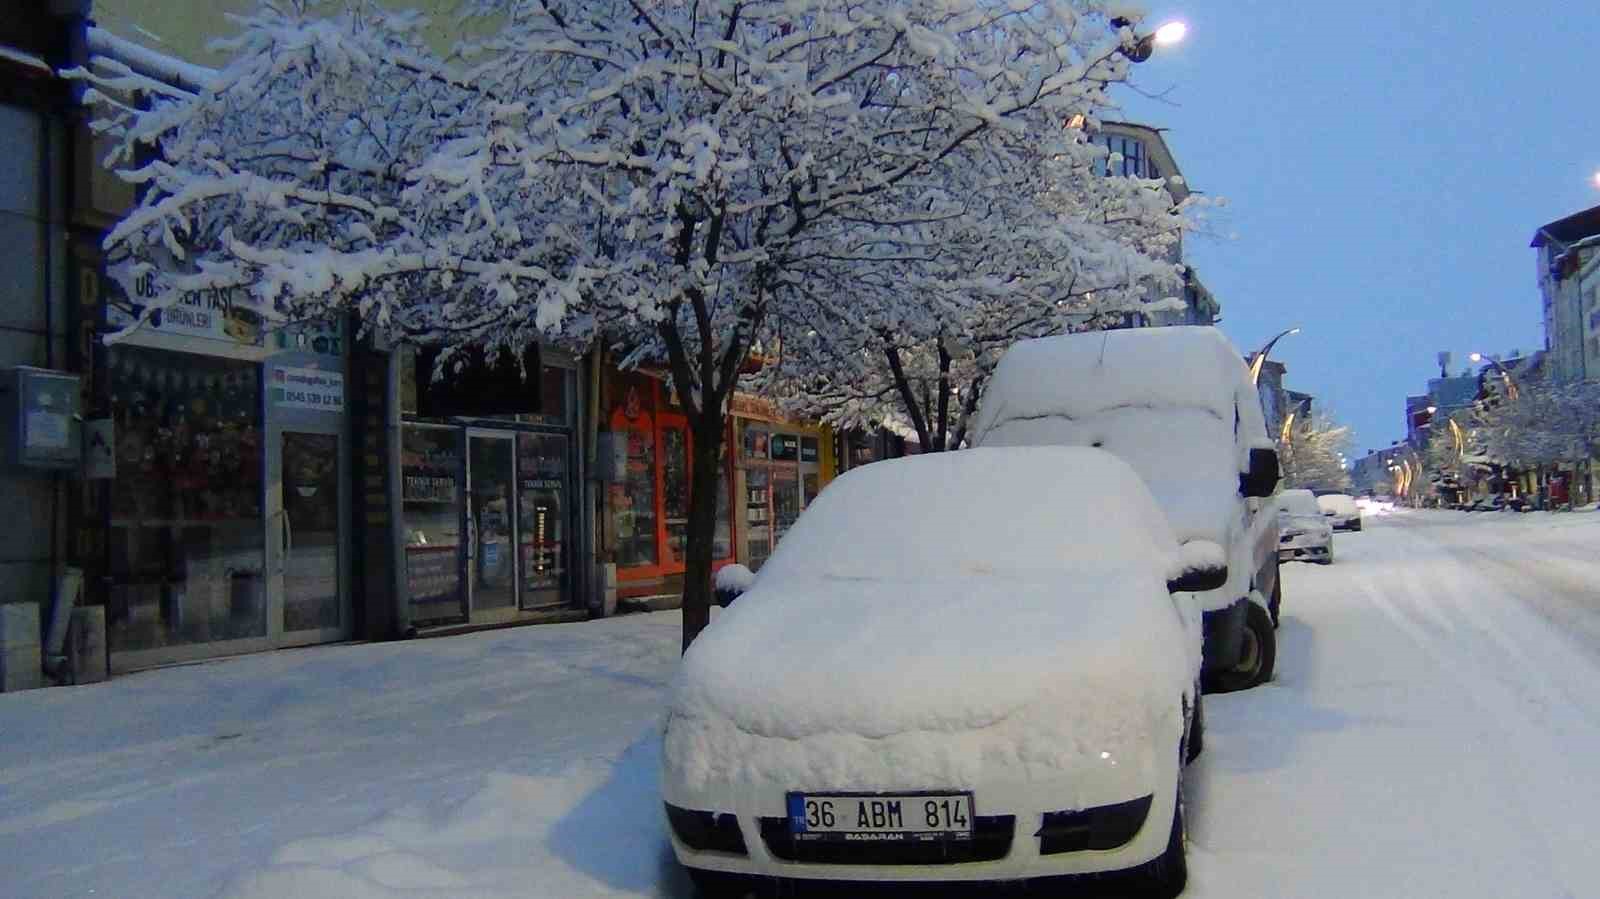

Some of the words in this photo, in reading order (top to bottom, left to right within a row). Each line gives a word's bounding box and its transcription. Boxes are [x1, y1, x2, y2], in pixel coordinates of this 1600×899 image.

[806, 800, 836, 828] 36
[857, 799, 903, 828] ABM
[924, 799, 967, 828] 814
